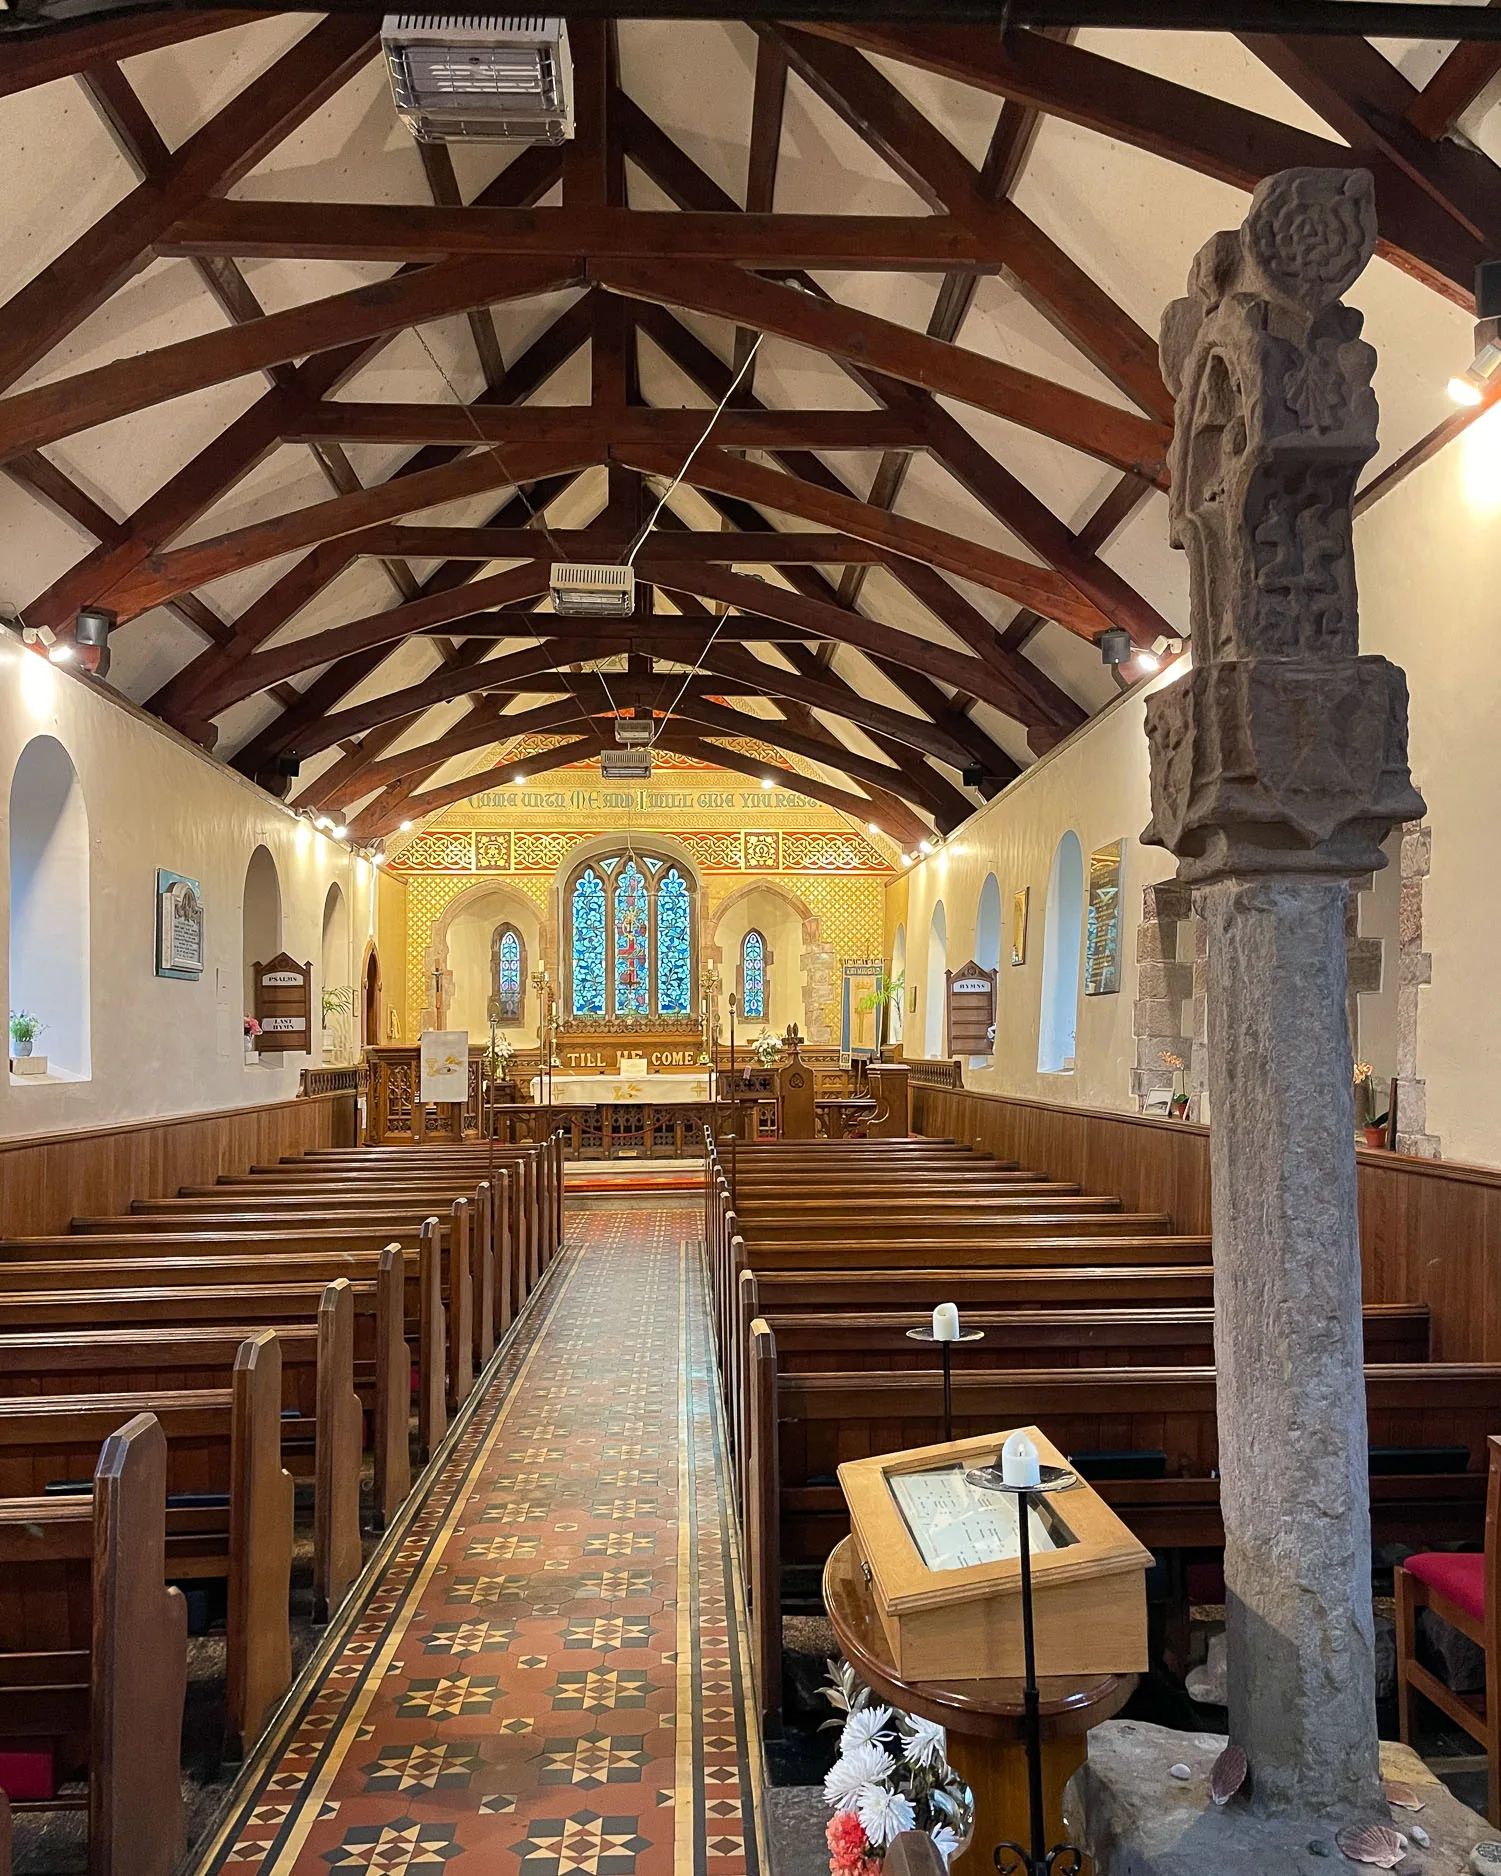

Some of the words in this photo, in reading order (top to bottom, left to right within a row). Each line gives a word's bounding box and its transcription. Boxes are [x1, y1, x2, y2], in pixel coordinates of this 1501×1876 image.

[467, 792, 518, 809] COME
[522, 792, 566, 808] UNTO
[570, 790, 600, 809] ME
[602, 793, 634, 808] AND
[648, 793, 693, 808] WILL
[697, 793, 735, 808] GIVE
[739, 793, 772, 808] YOU
[567, 1053, 606, 1067] TILL
[652, 1051, 694, 1066] COME
